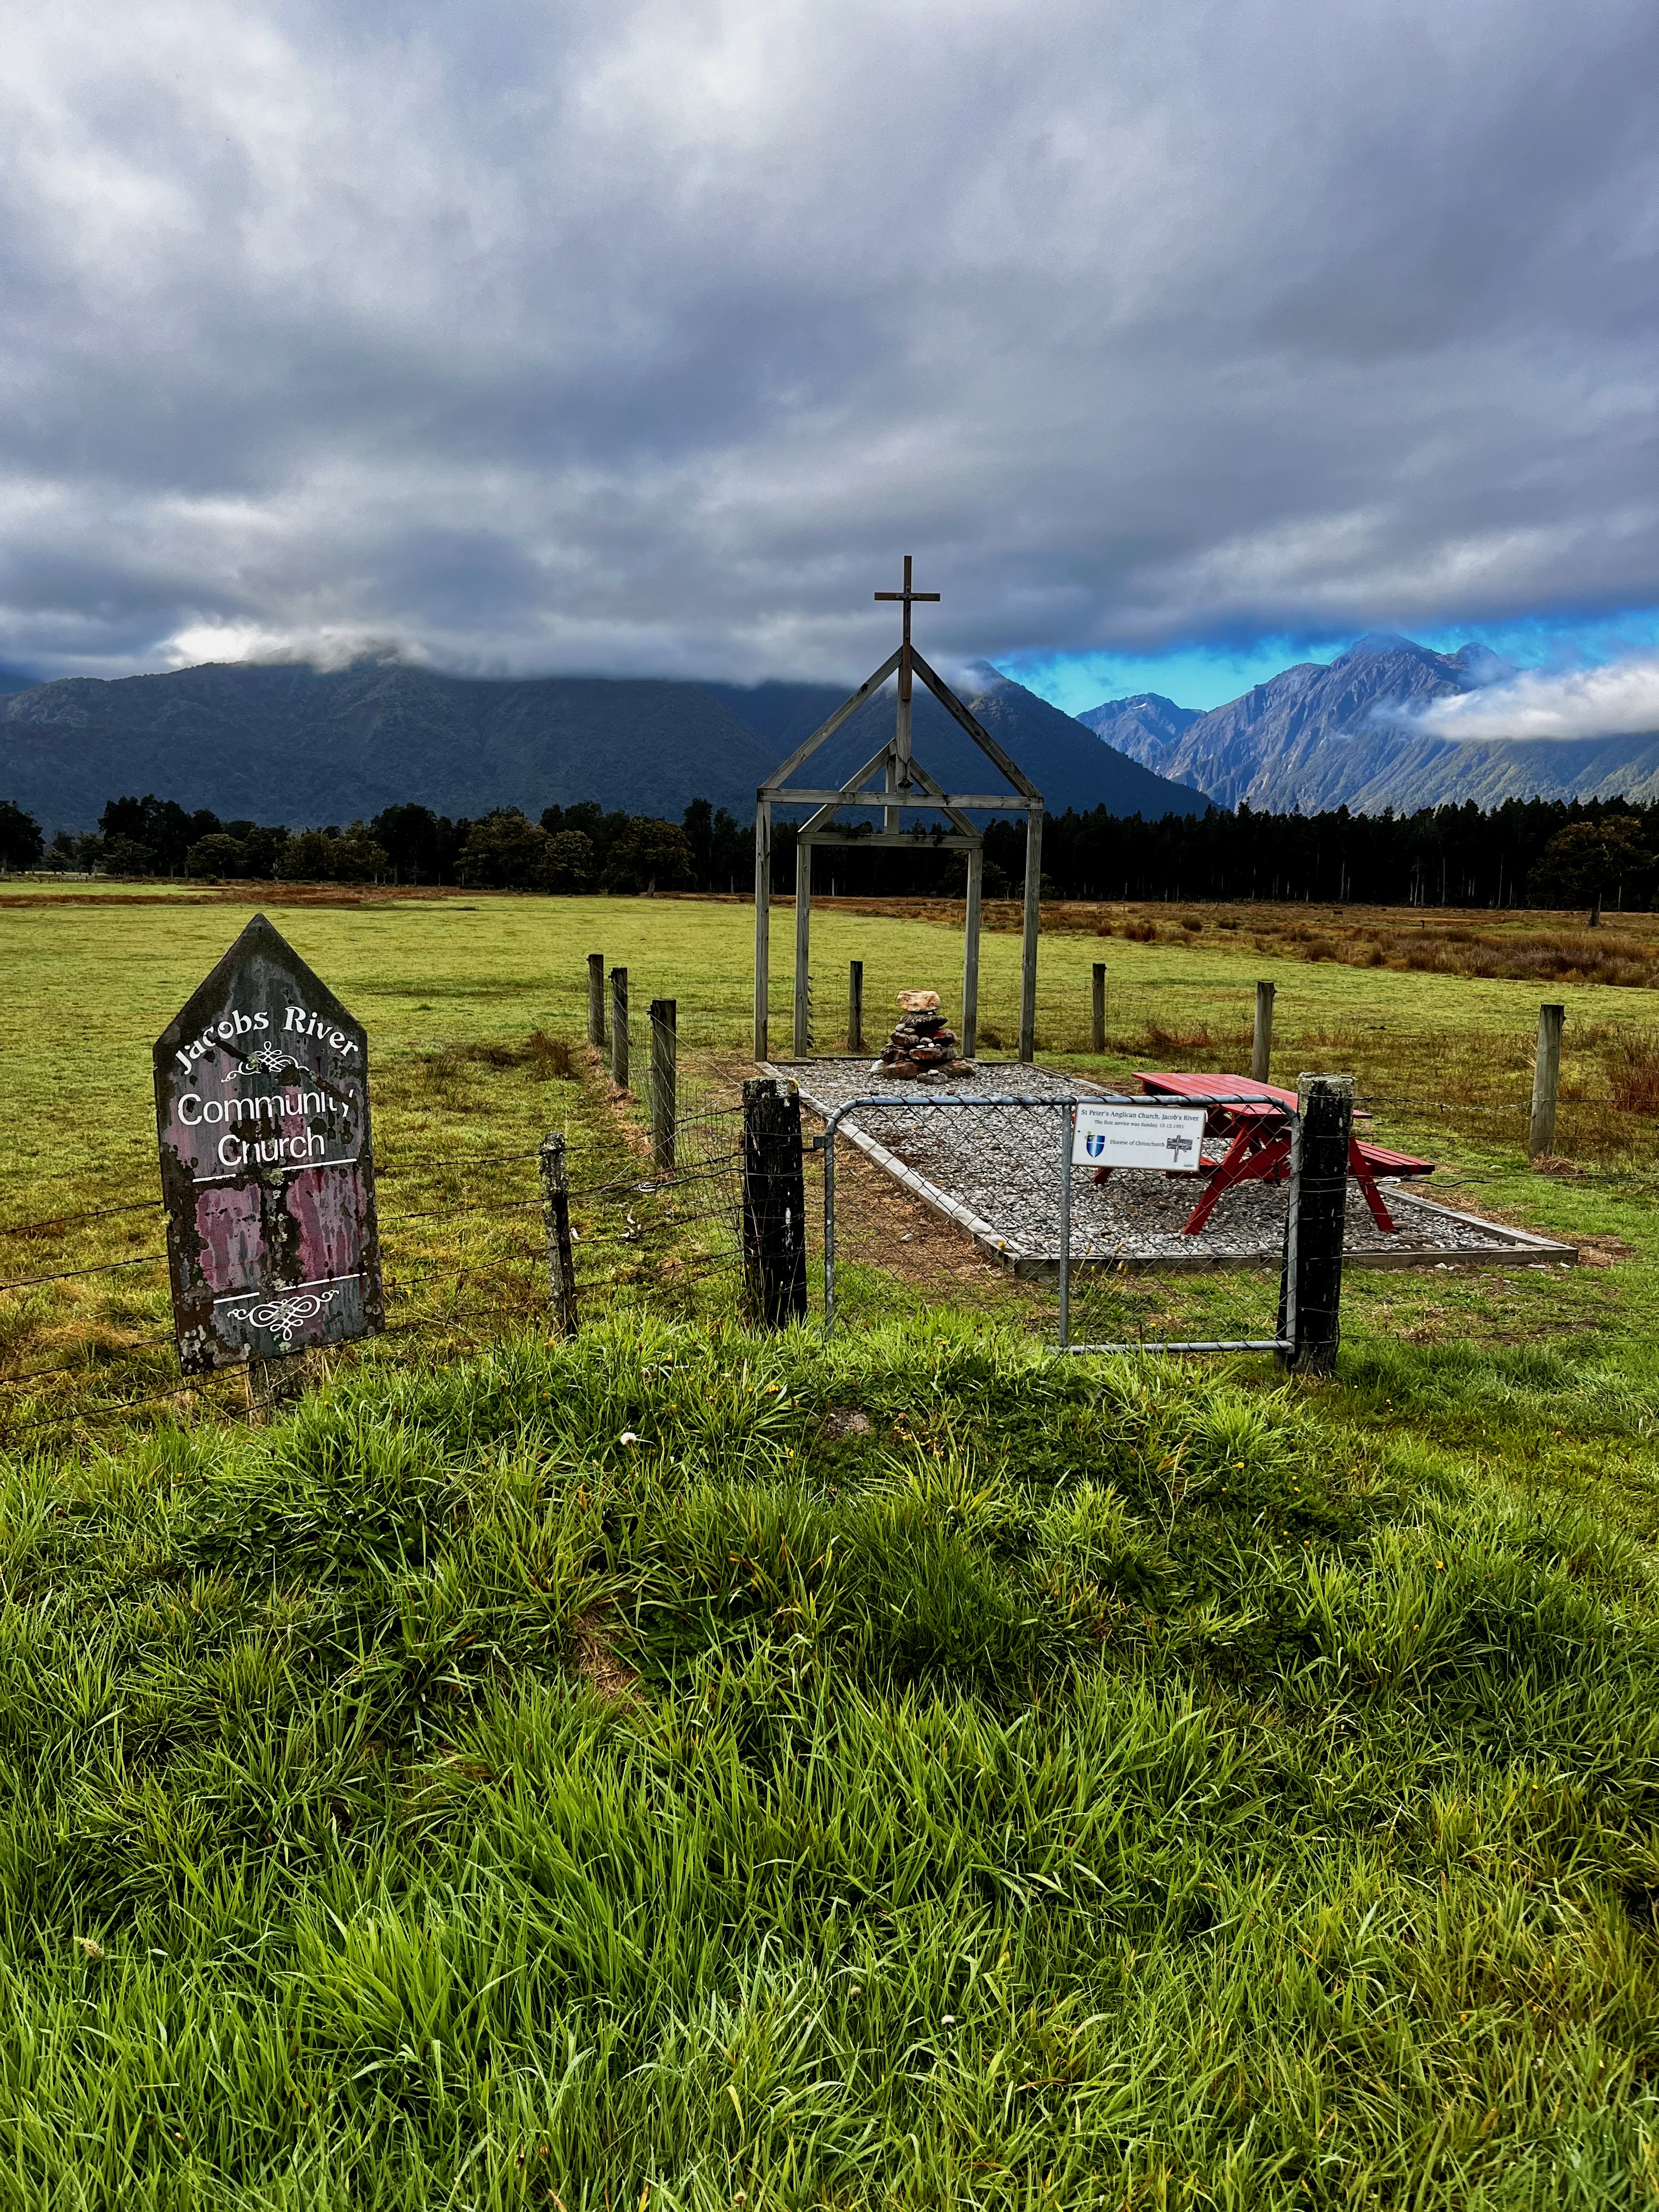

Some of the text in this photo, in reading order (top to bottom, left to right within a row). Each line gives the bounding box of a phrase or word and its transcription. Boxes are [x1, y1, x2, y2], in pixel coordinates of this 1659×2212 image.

[175, 1006, 359, 1075] Jacobs River
[1110, 1111, 1137, 1119] Anglican
[218, 1126, 325, 1166] Church
